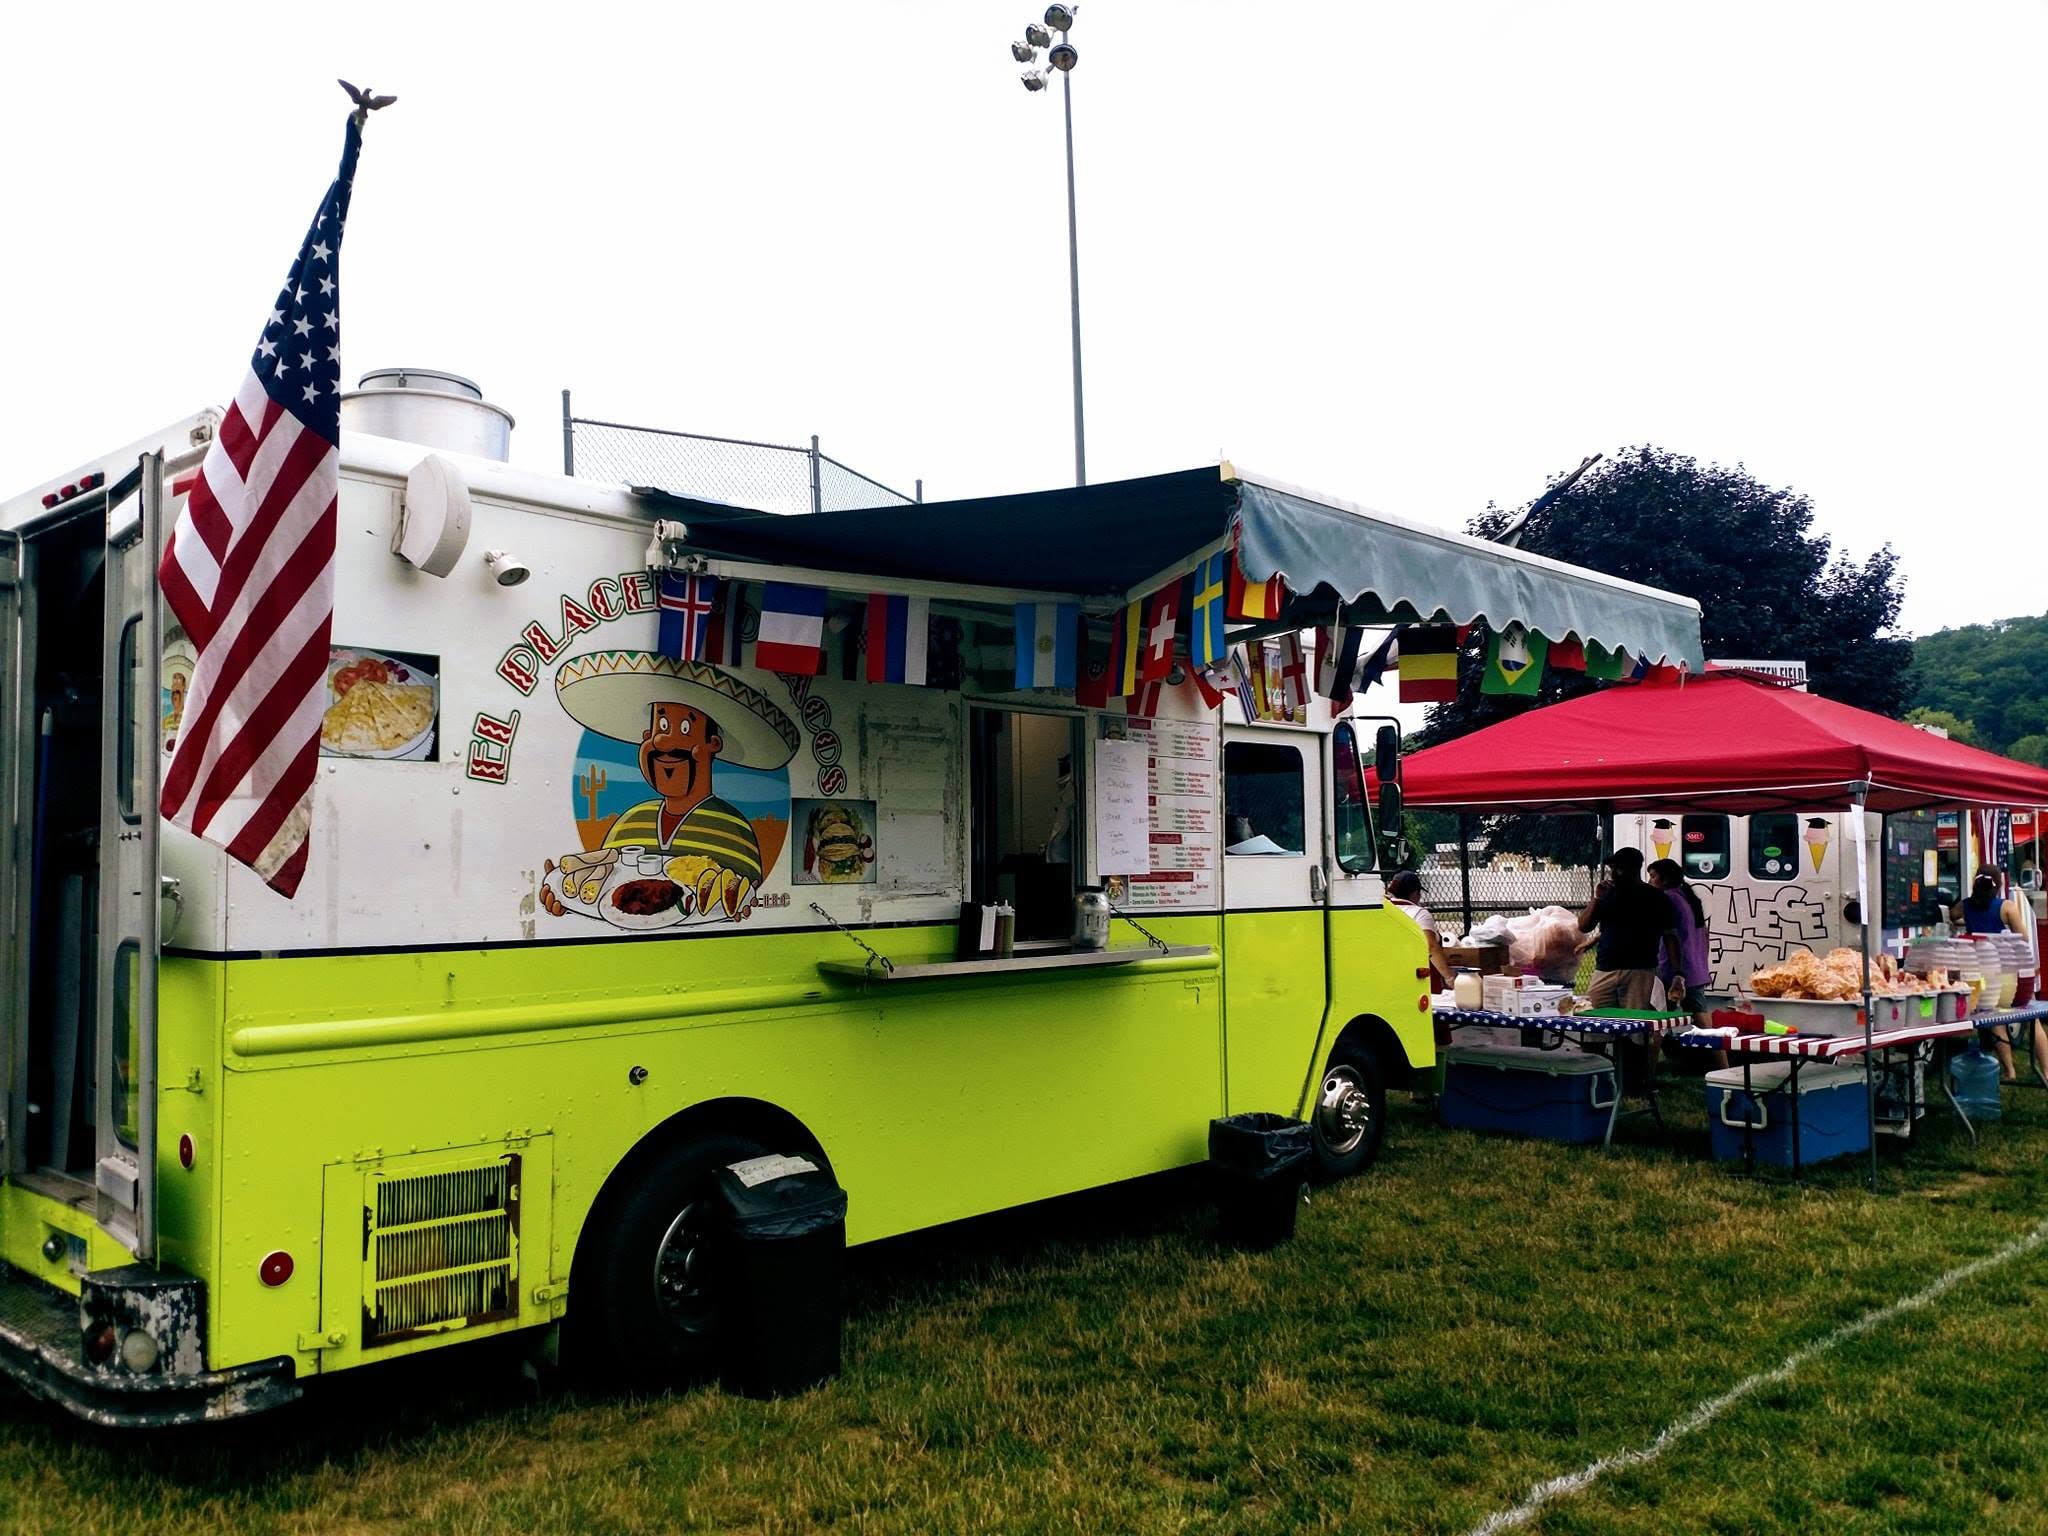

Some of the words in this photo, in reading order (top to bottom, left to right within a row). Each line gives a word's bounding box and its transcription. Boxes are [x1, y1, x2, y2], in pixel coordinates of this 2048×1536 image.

[466, 710, 521, 785] EL
[774, 673, 848, 797] ACOS
[1688, 883, 1828, 940] OLLEGE
